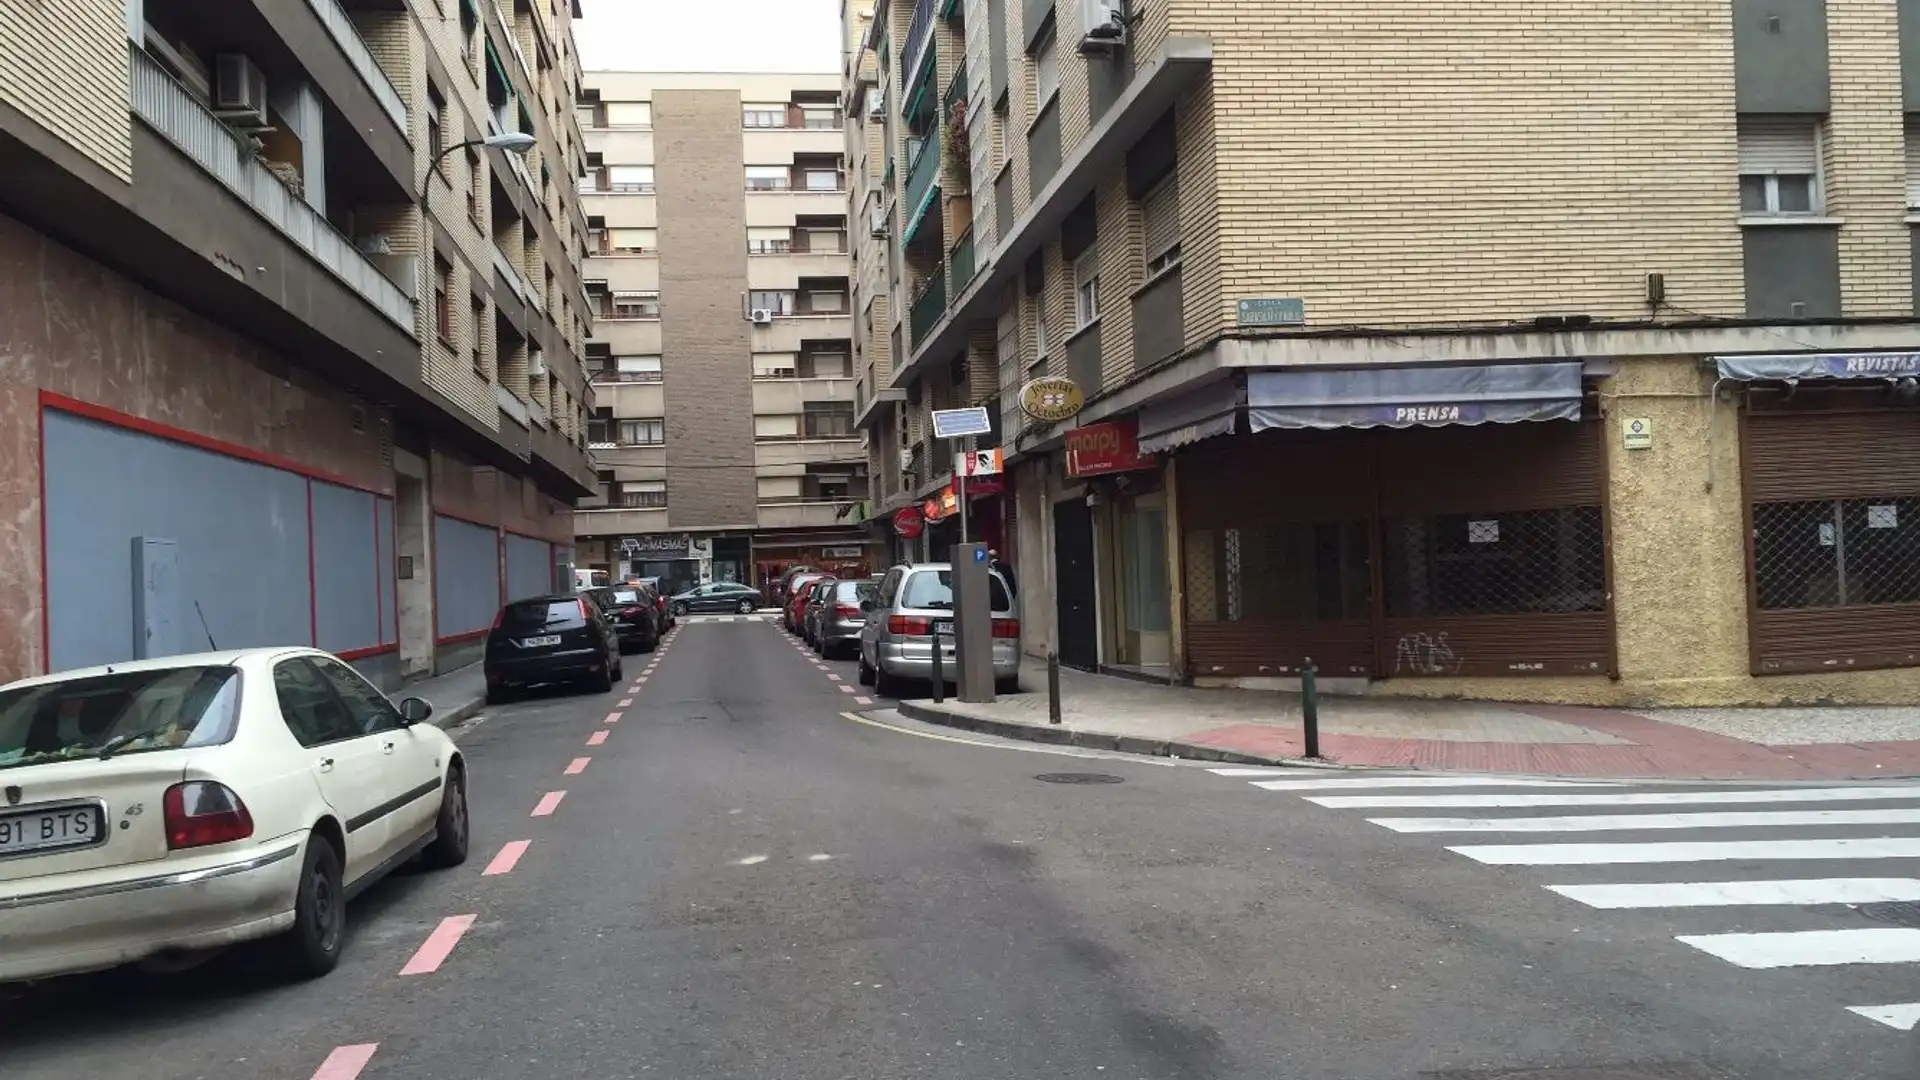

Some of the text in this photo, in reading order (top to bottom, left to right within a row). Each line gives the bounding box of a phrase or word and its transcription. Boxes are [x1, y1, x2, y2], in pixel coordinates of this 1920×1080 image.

[1846, 355, 1918, 372] REVISTAS
[1396, 406, 1459, 422] PRENSA
[125, 803, 144, 816] 45
[41, 811, 89, 839] BTS
